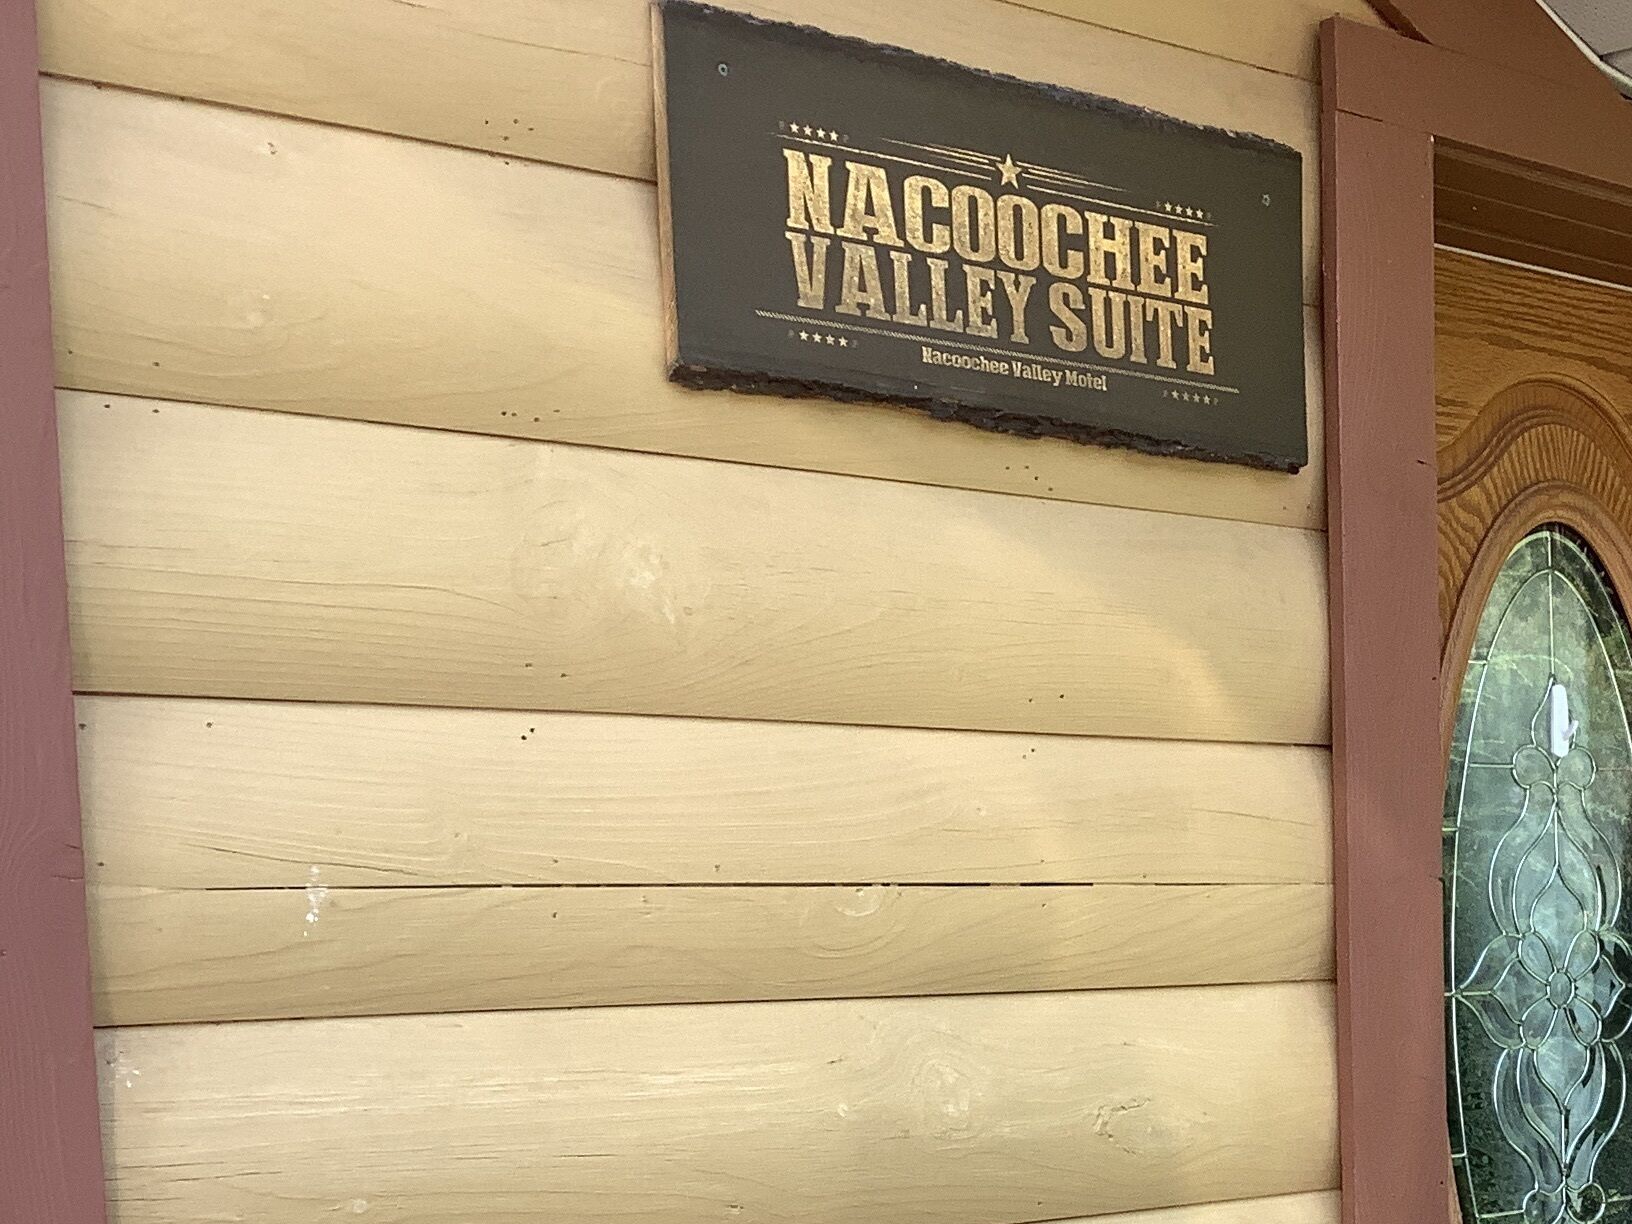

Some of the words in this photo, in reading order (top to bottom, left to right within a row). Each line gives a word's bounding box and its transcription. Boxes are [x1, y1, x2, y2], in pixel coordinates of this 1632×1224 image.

[784, 149, 1209, 305] NACOOCHEE
[786, 231, 1036, 344] VALLEY
[1048, 283, 1215, 375] SUITE
[921, 347, 1009, 376] Nacoochee
[1012, 361, 1062, 386] Valley
[1065, 371, 1107, 391] Motel
